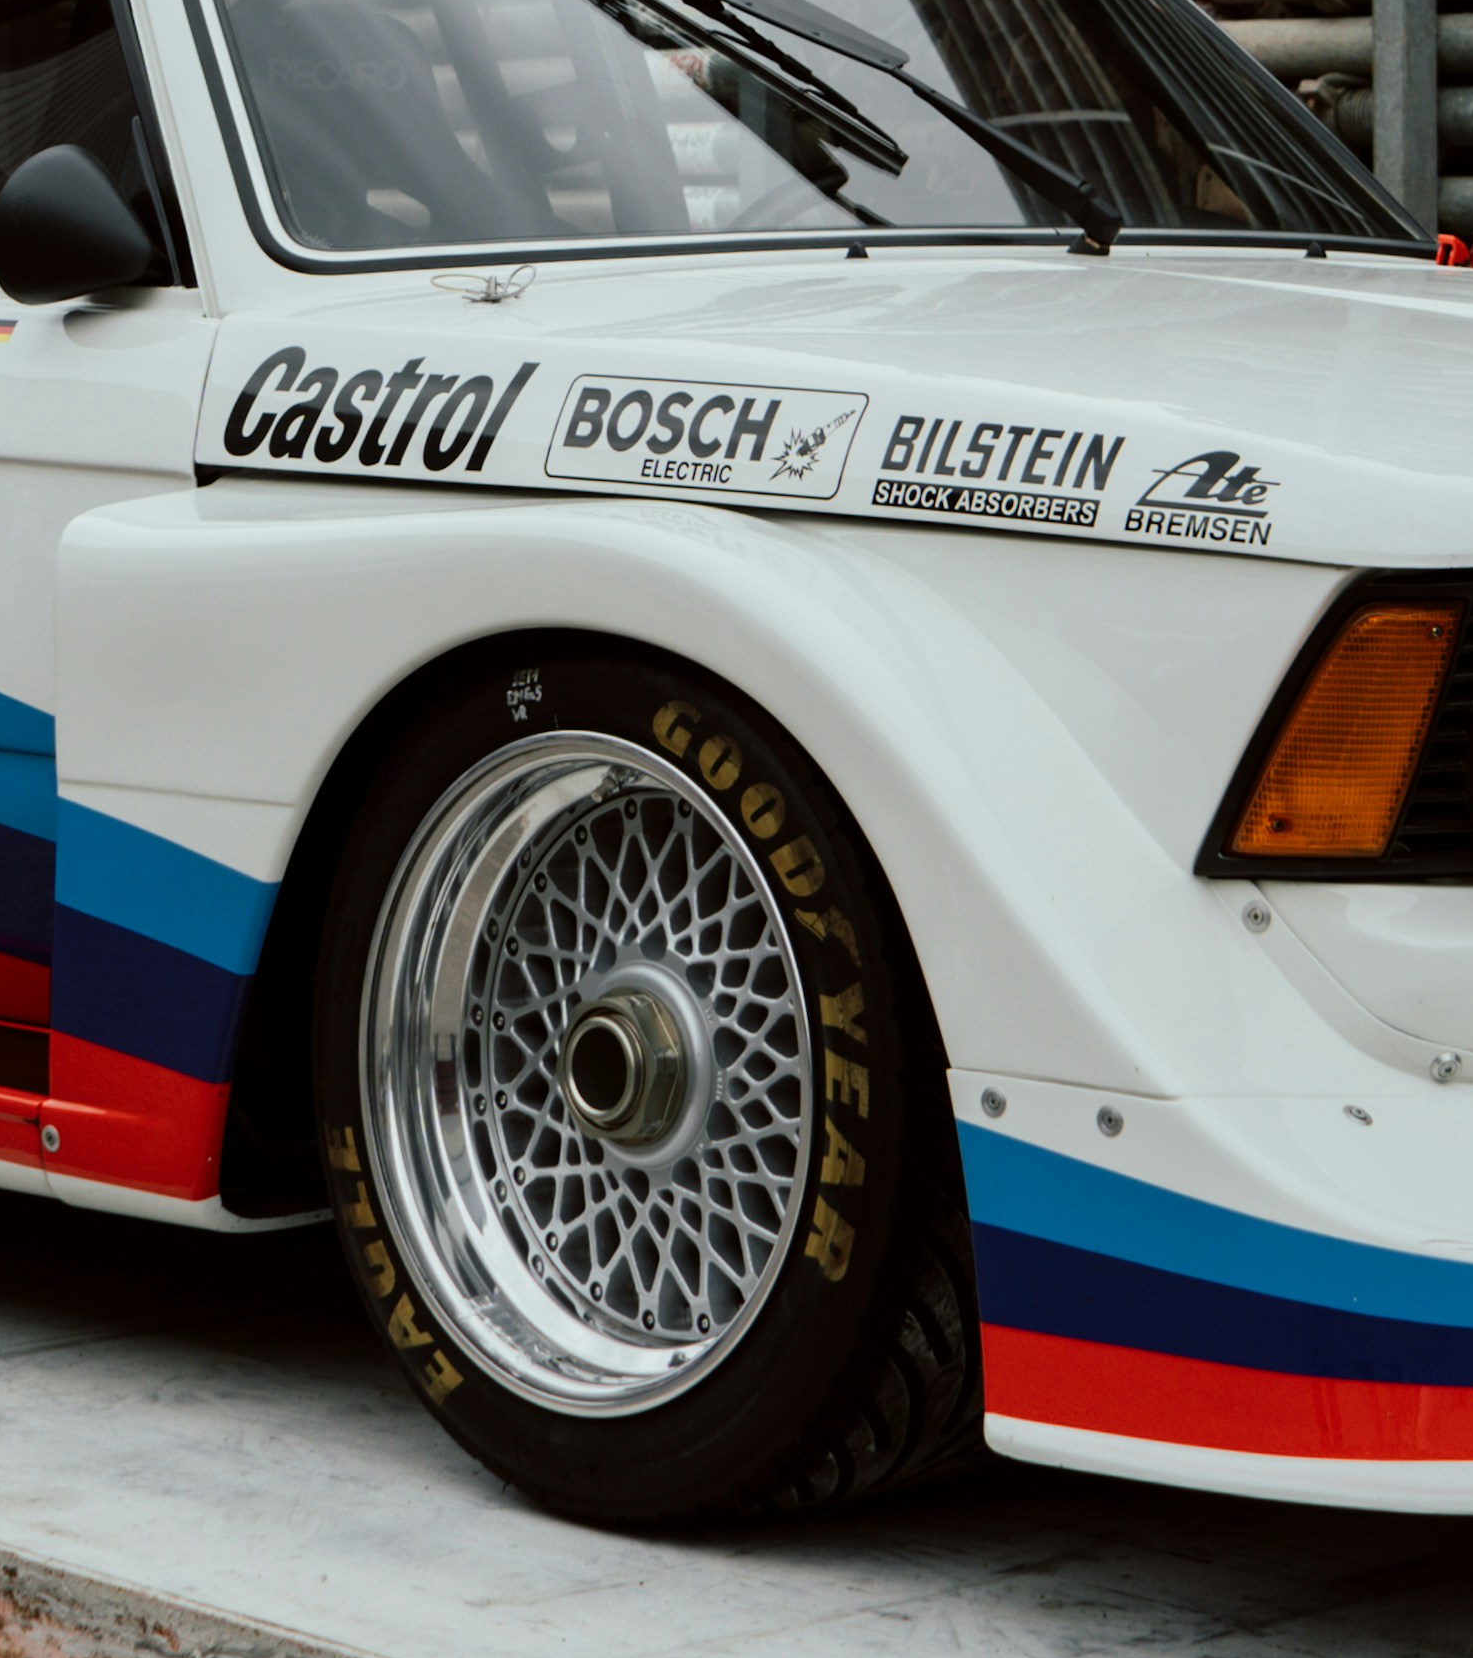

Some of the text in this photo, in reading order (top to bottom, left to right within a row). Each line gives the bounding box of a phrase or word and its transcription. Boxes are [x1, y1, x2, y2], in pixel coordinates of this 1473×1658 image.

[223, 345, 541, 472] Castrol
[563, 386, 782, 462] BOSCH
[640, 458, 733, 484] ELECTRIC
[879, 414, 1127, 492] BILSTEIN
[873, 480, 1098, 525] SHOCK ABSORBERS
[1124, 509, 1273, 546] BREMSEN
[651, 697, 871, 1283] GOODYEAR
[328, 1123, 466, 1405] EAGLE
